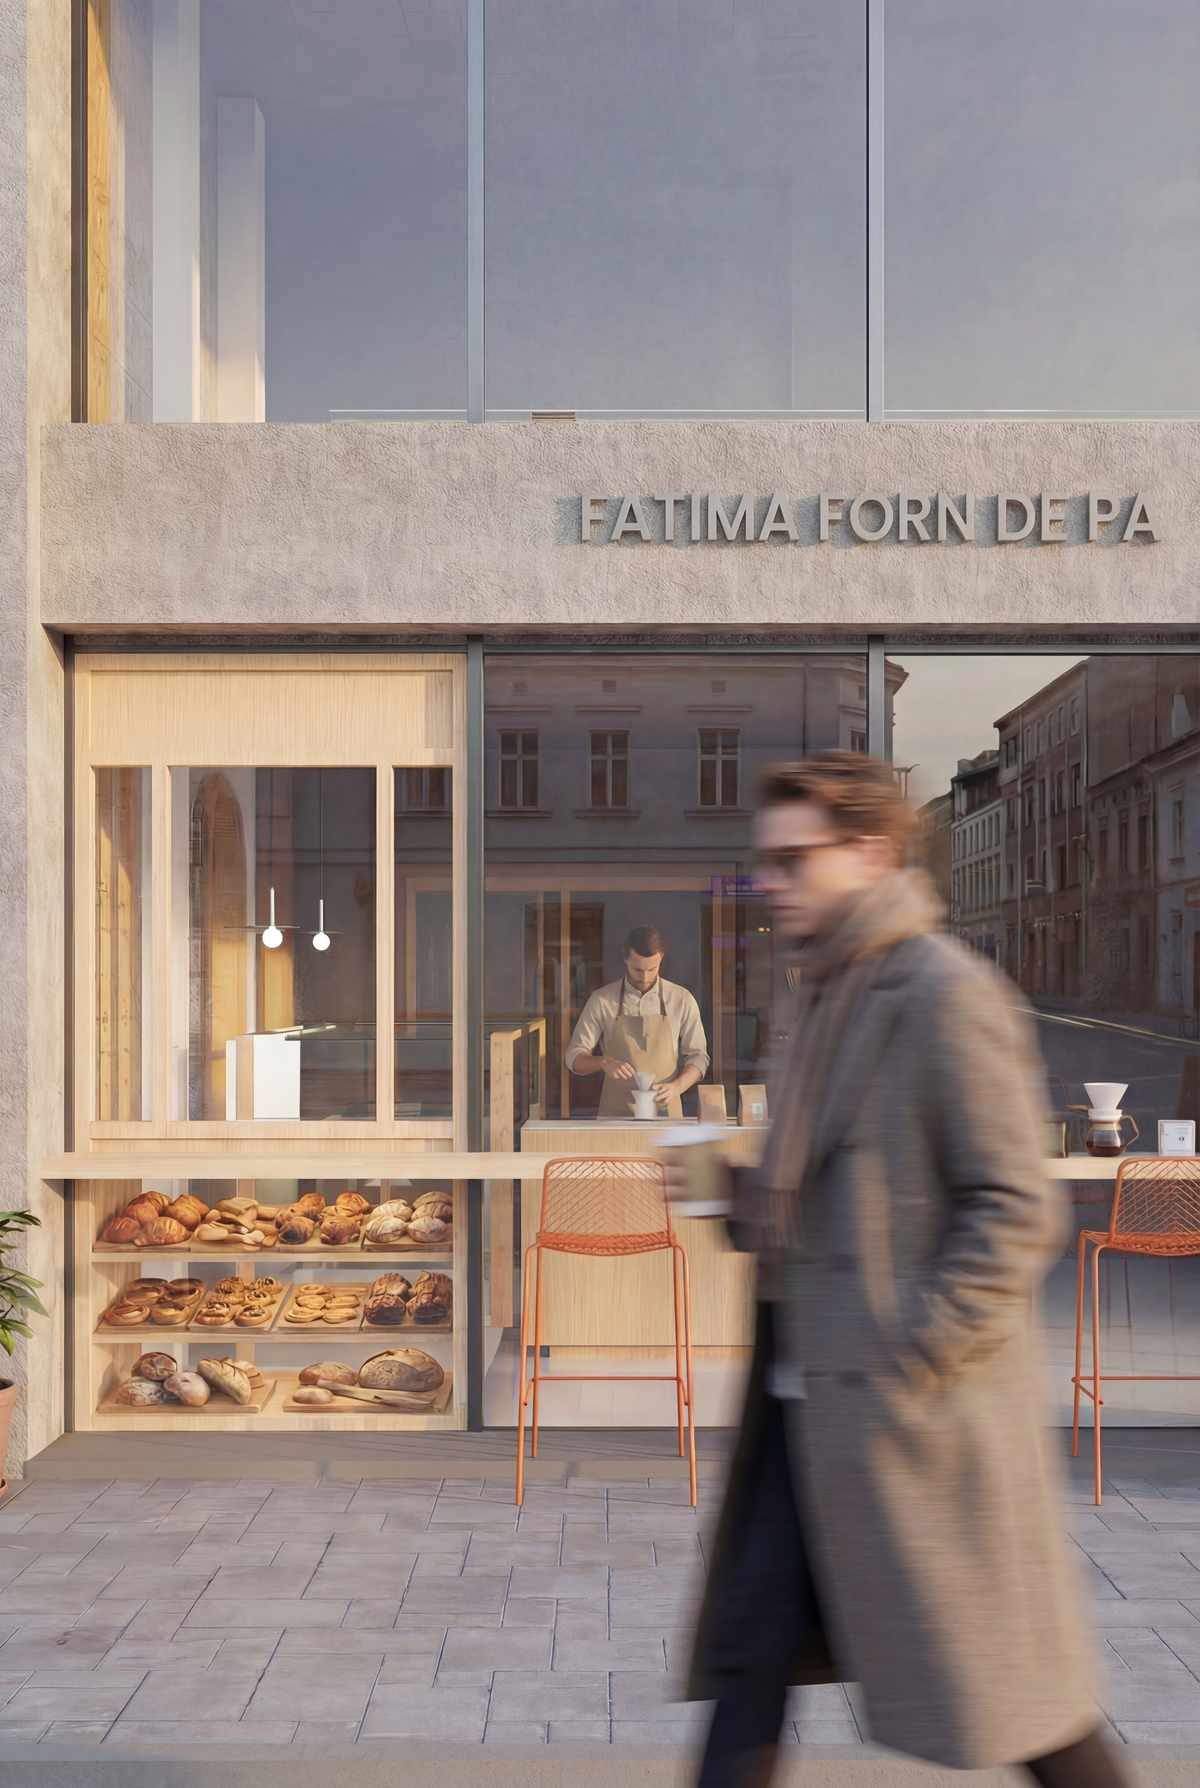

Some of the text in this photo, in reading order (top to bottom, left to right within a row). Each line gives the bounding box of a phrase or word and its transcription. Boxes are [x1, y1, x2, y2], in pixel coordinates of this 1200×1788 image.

[581, 493, 1159, 542] FATIMA FORN DE PA
